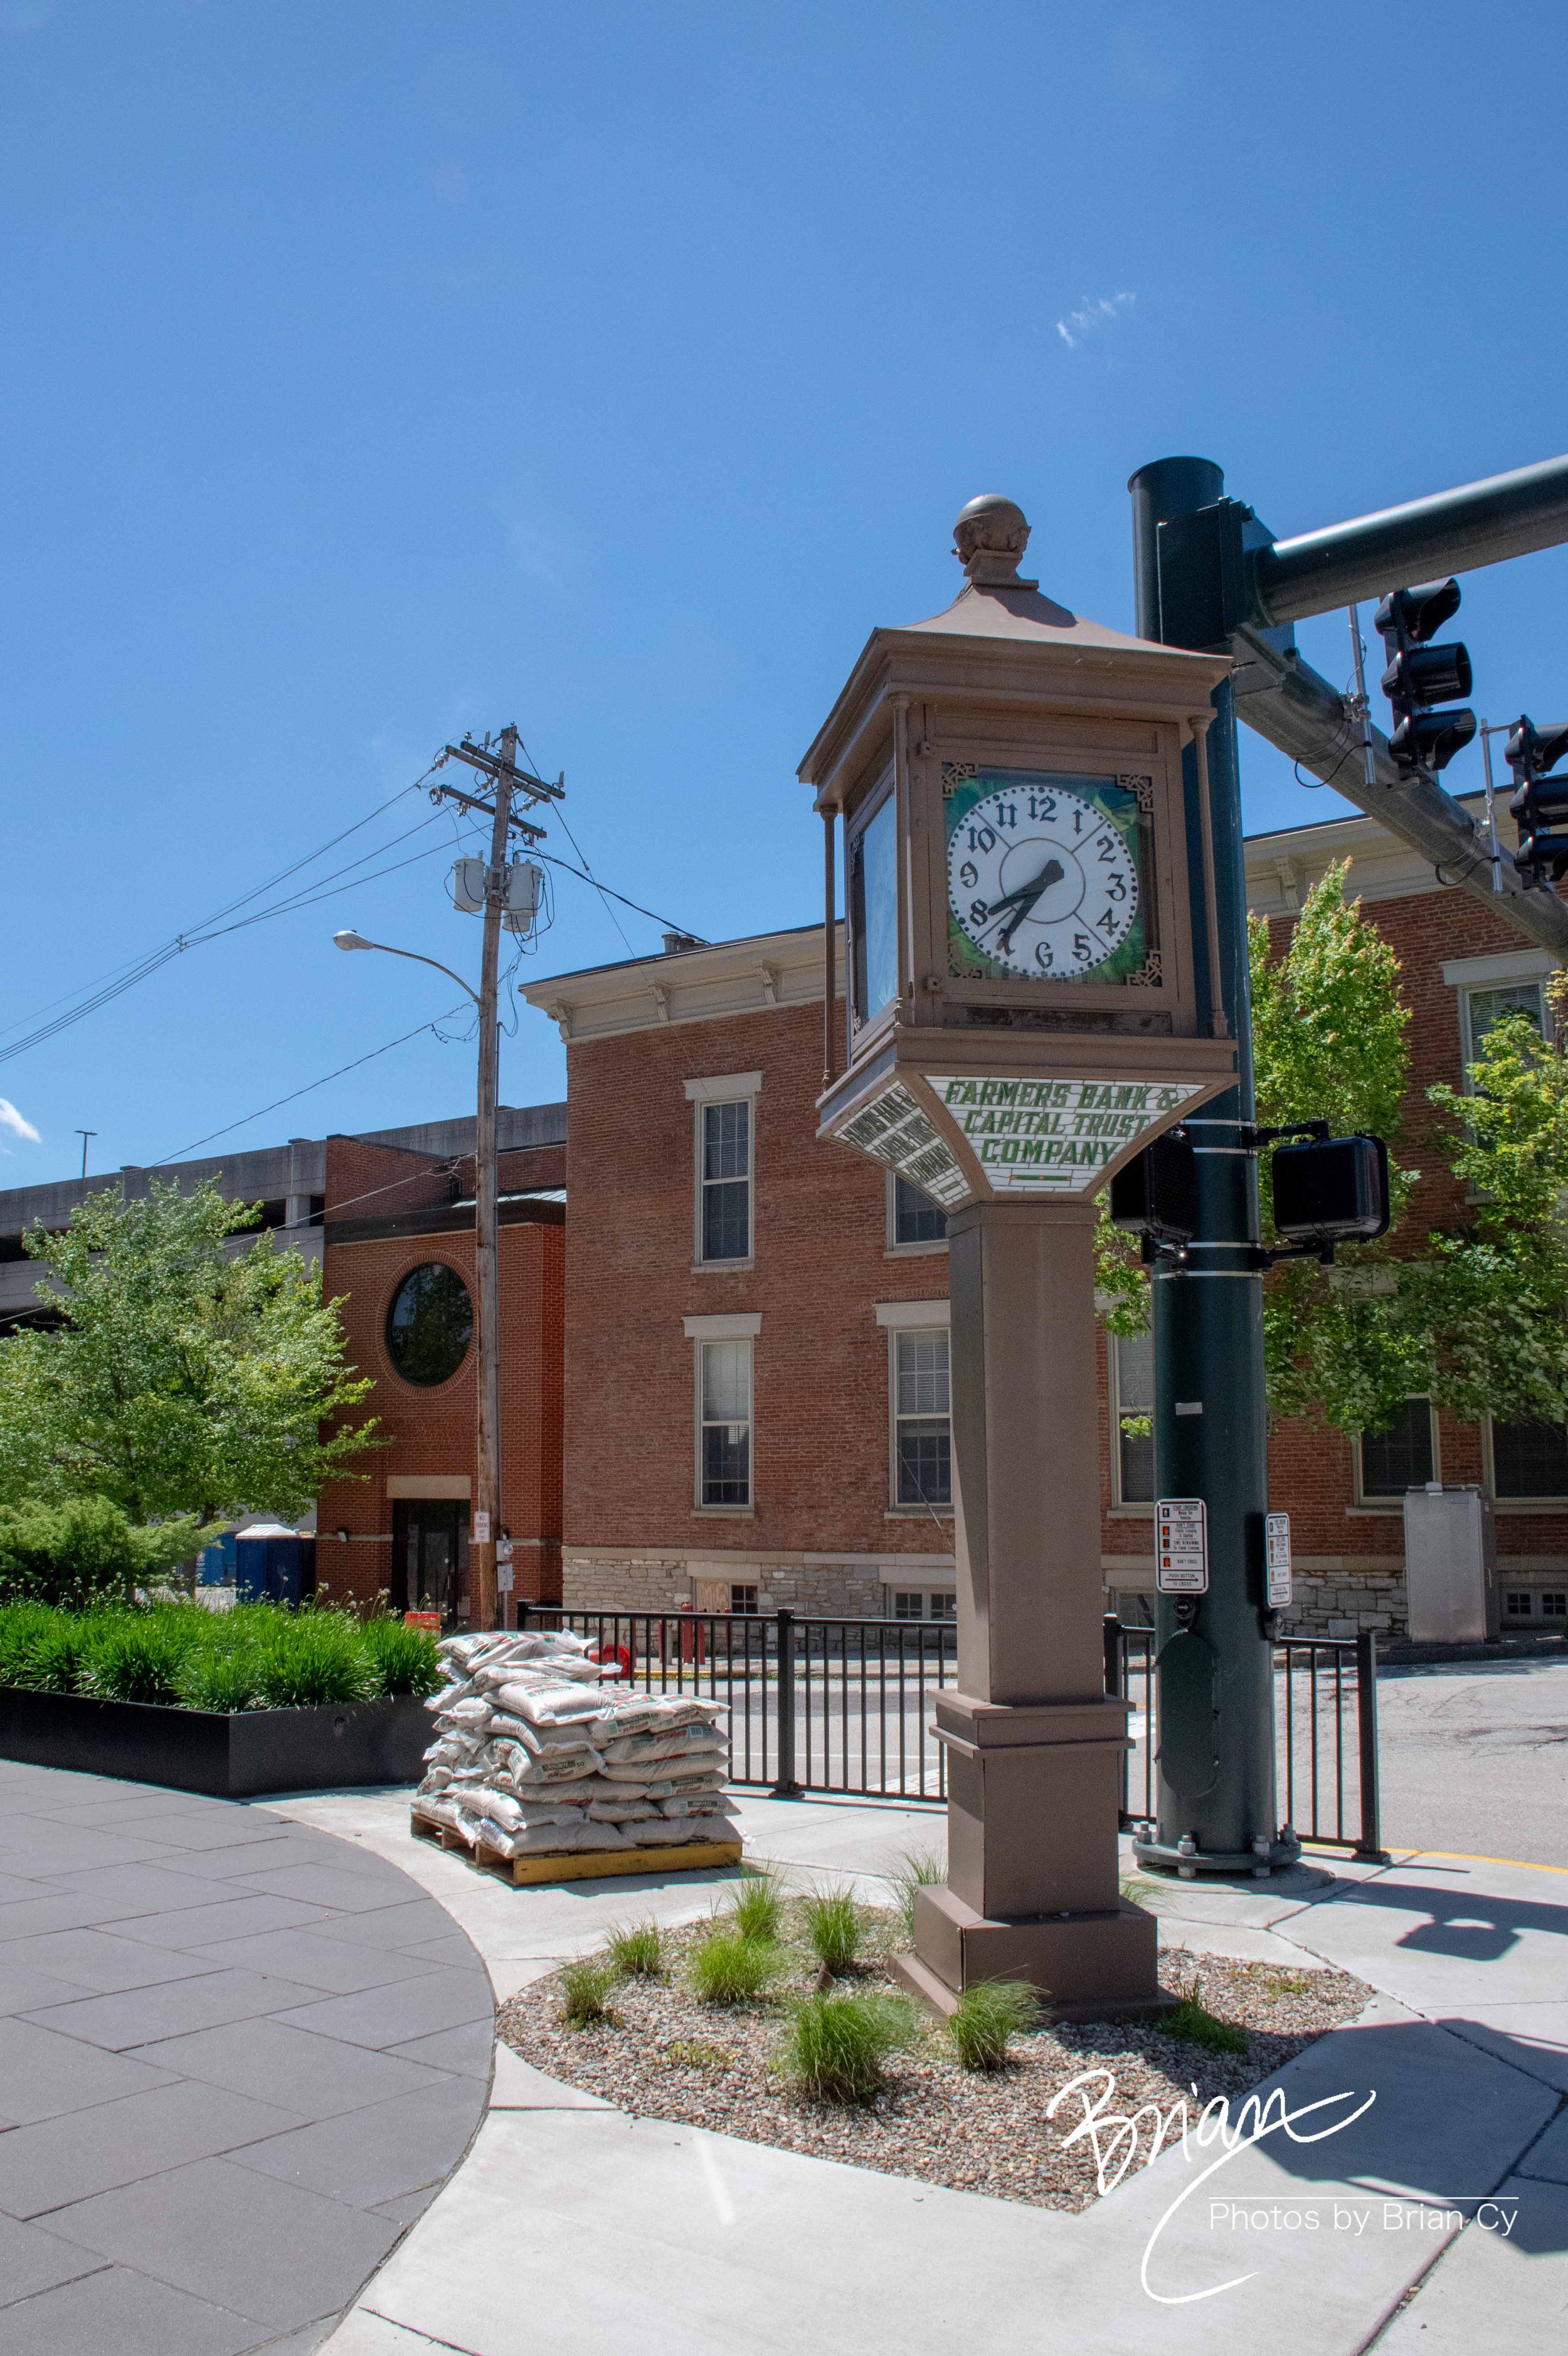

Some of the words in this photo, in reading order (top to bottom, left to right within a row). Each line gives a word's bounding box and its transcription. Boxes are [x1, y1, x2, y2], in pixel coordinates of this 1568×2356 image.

[995, 802, 1017, 829] 11
[1027, 794, 1058, 823] 12
[1072, 809, 1083, 836] 1
[967, 825, 996, 855] 10
[1096, 835, 1116, 863] 2
[960, 861, 978, 888] 9
[1104, 873, 1126, 902] 3
[970, 898, 988, 928] 8
[1096, 907, 1120, 938] 4
[1035, 942, 1054, 969] 6
[1071, 933, 1091, 961] 5
[945, 1081, 1071, 1108] FARMERS
[1078, 1085, 1153, 1110] BANK
[1156, 1088, 1179, 1110] &
[963, 1110, 1065, 1135] CAPITAL
[1073, 1113, 1151, 1137] TRUST
[981, 1138, 1120, 1165] COMPANY
